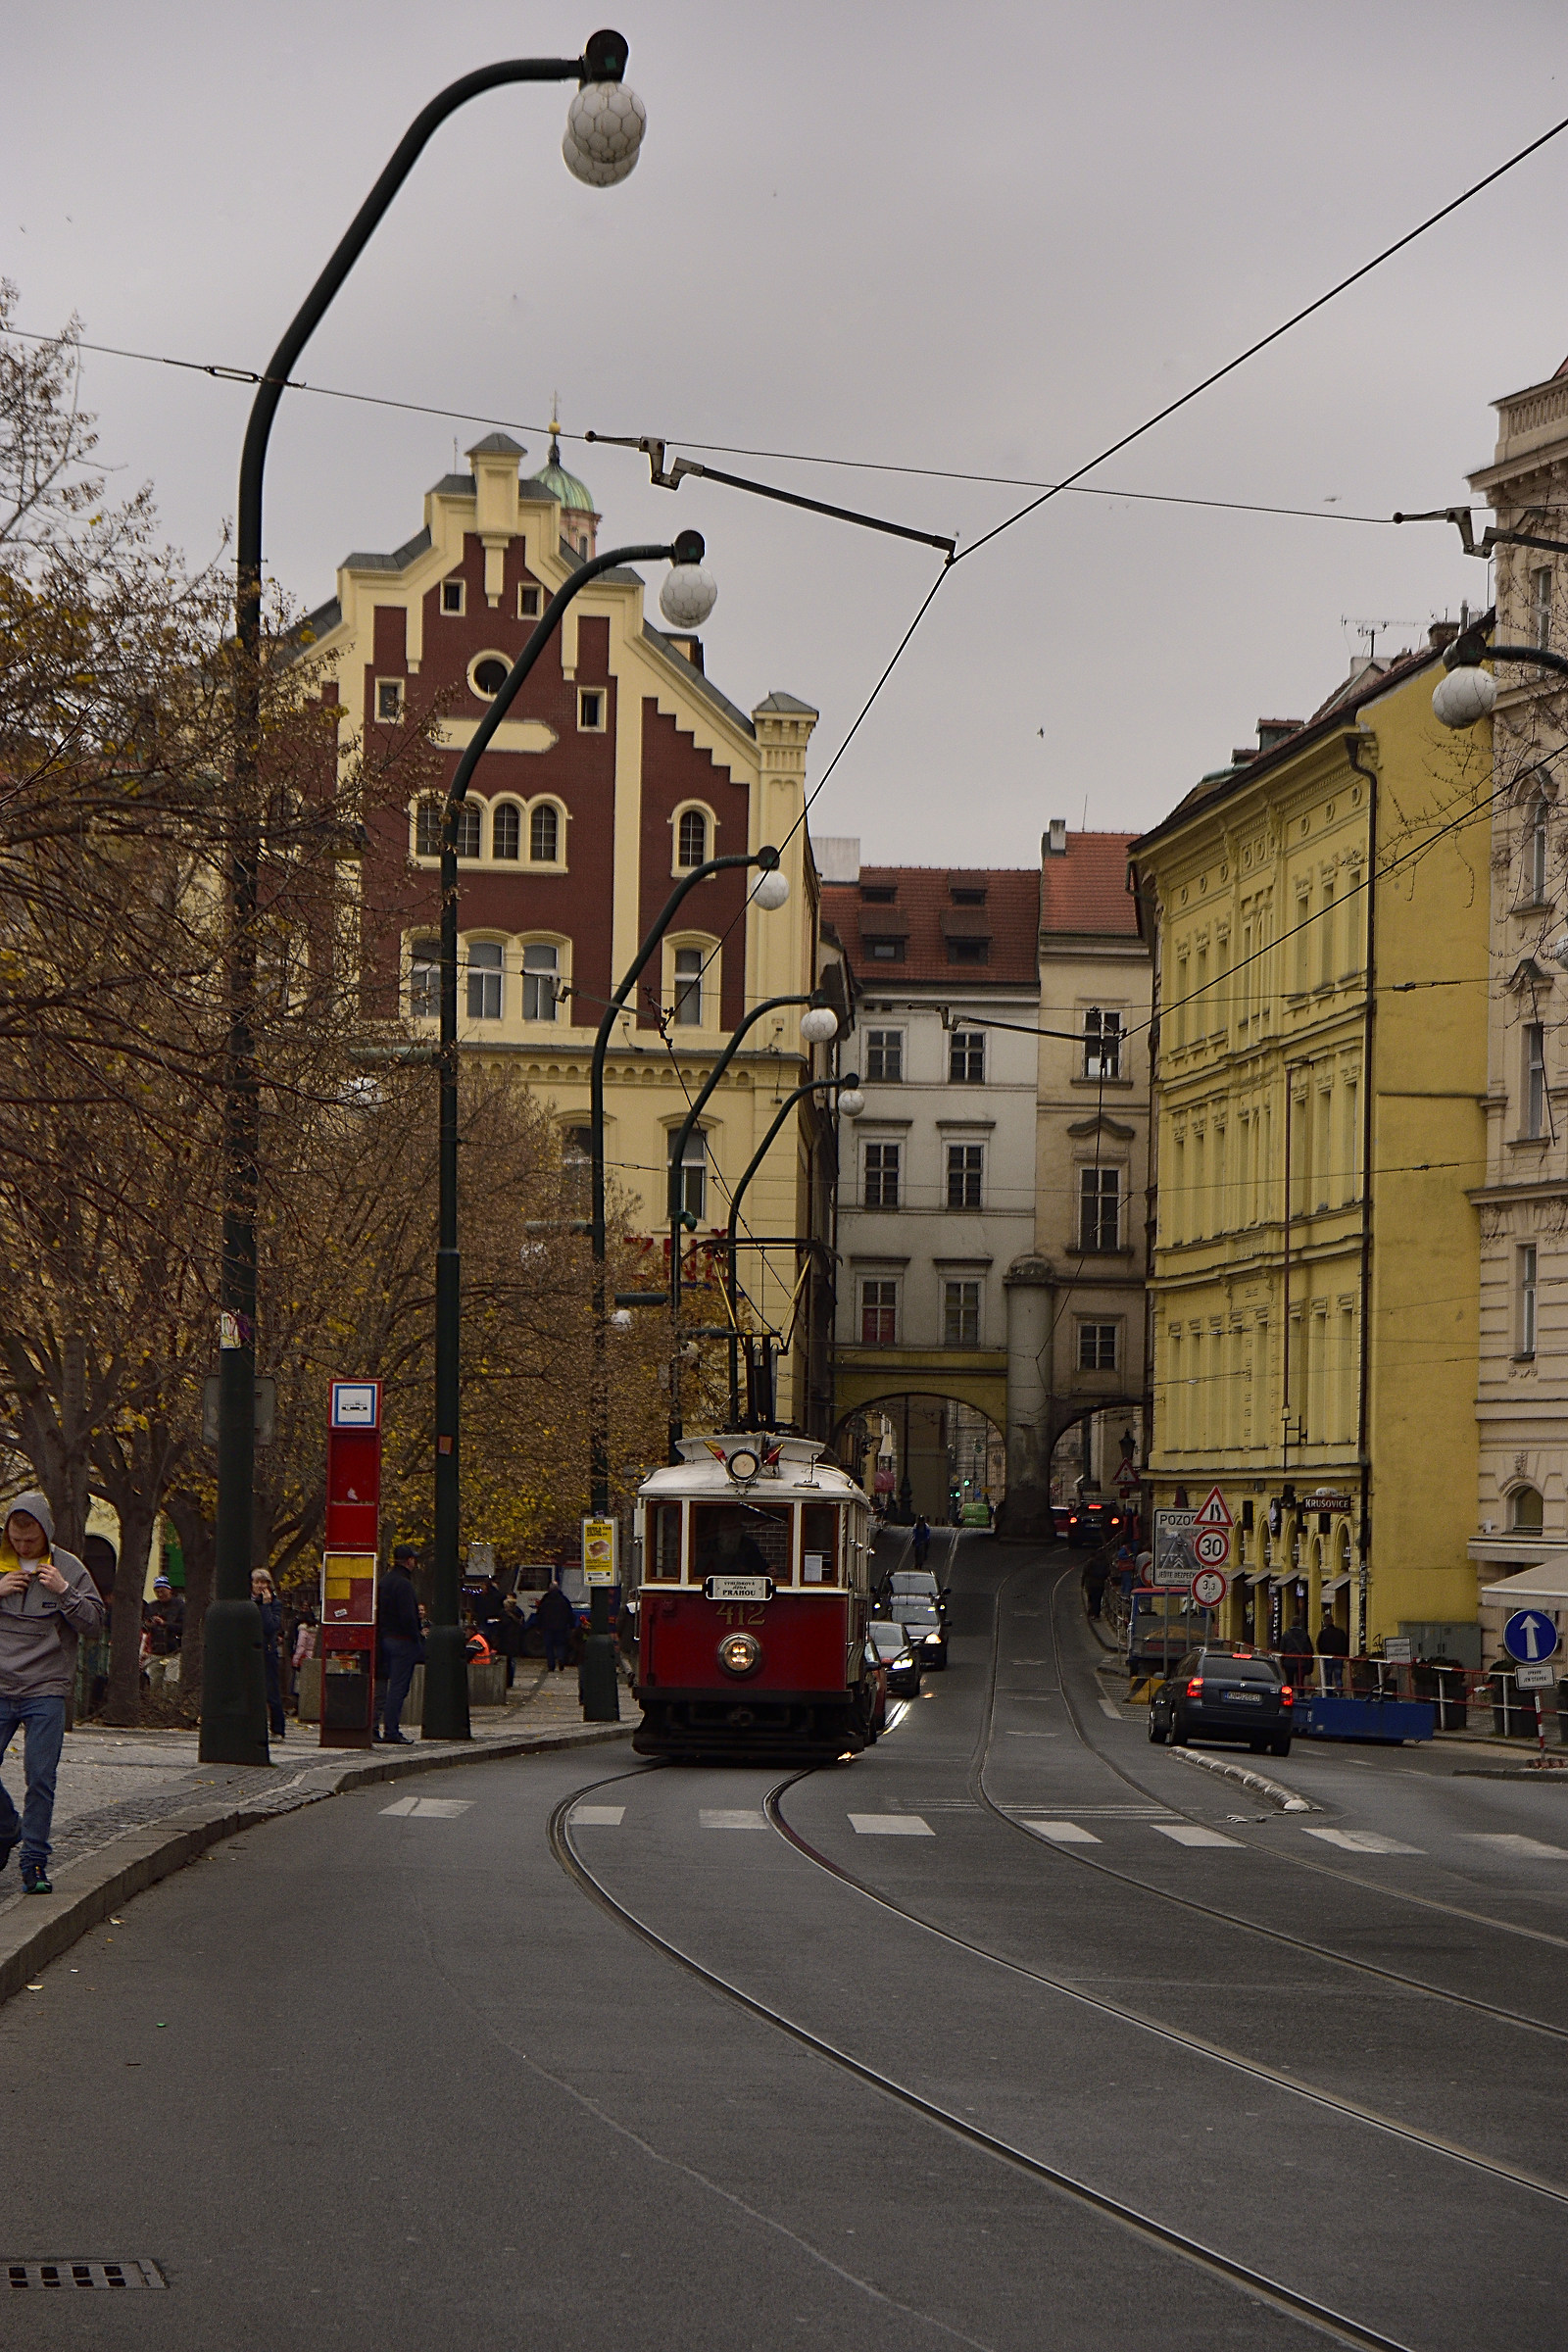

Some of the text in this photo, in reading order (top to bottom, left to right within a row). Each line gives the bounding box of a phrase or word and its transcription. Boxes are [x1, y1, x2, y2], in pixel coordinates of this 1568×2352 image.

[1304, 1497, 1349, 1509] KRUŠOVICE
[1201, 1538, 1222, 1556] 30
[715, 1601, 766, 1626] 412
